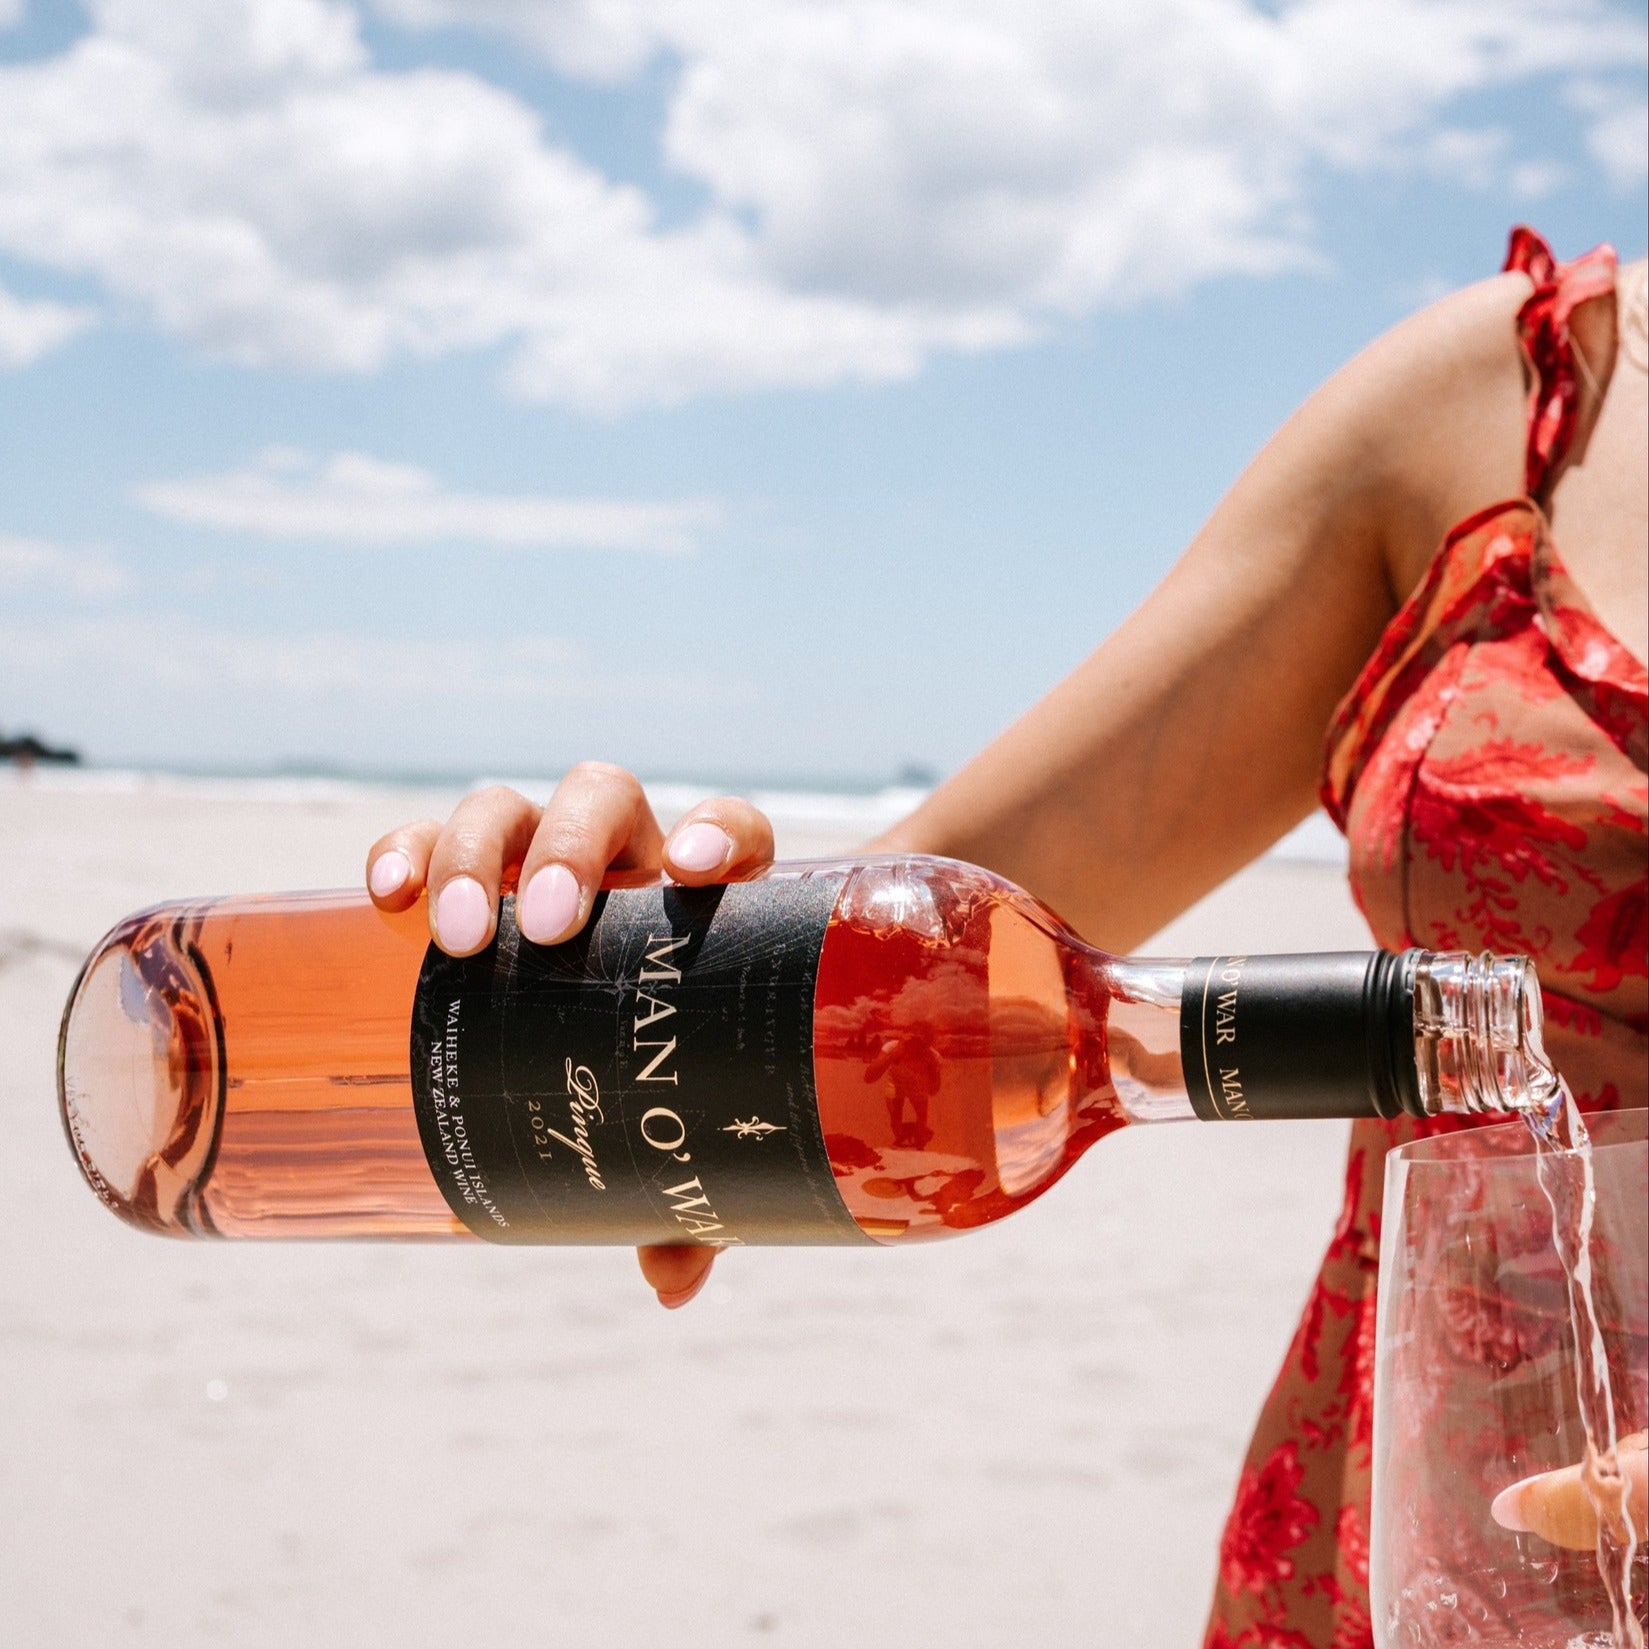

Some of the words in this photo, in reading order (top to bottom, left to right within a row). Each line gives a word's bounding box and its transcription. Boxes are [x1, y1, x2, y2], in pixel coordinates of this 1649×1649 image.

[634, 932, 692, 1086] MAN
[1215, 989, 1238, 1046] WAR
[430, 1040, 443, 1083] NEW
[446, 999, 462, 1089] WAIHEKE
[432, 1087, 459, 1166] ZEALAND
[448, 1094, 459, 1109] &
[547, 1056, 606, 1191] Pinque
[452, 1114, 476, 1170] PONUI
[528, 1100, 552, 1161] 2021
[453, 1168, 479, 1205] WINE
[469, 1174, 510, 1228] ISLANDS
